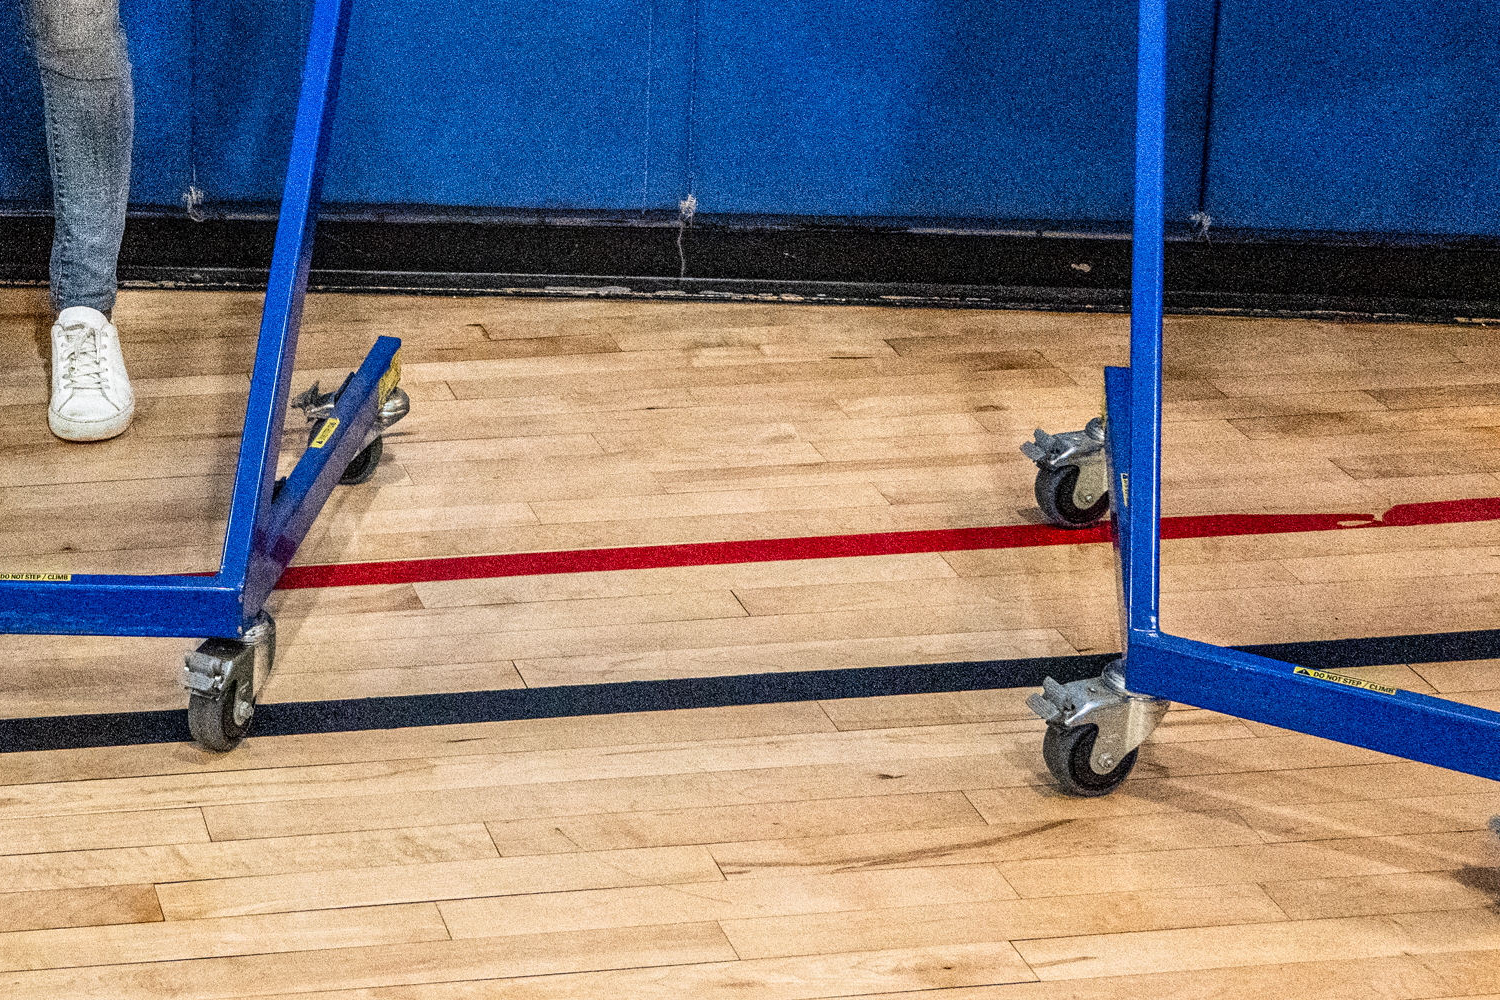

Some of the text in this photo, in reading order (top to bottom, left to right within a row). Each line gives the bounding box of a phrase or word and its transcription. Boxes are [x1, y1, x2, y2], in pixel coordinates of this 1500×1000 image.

[1313, 671, 1325, 679] DO
[1326, 674, 1341, 682] NOT
[1342, 677, 1362, 687] STEP
[1369, 683, 1394, 694] CLIMB
